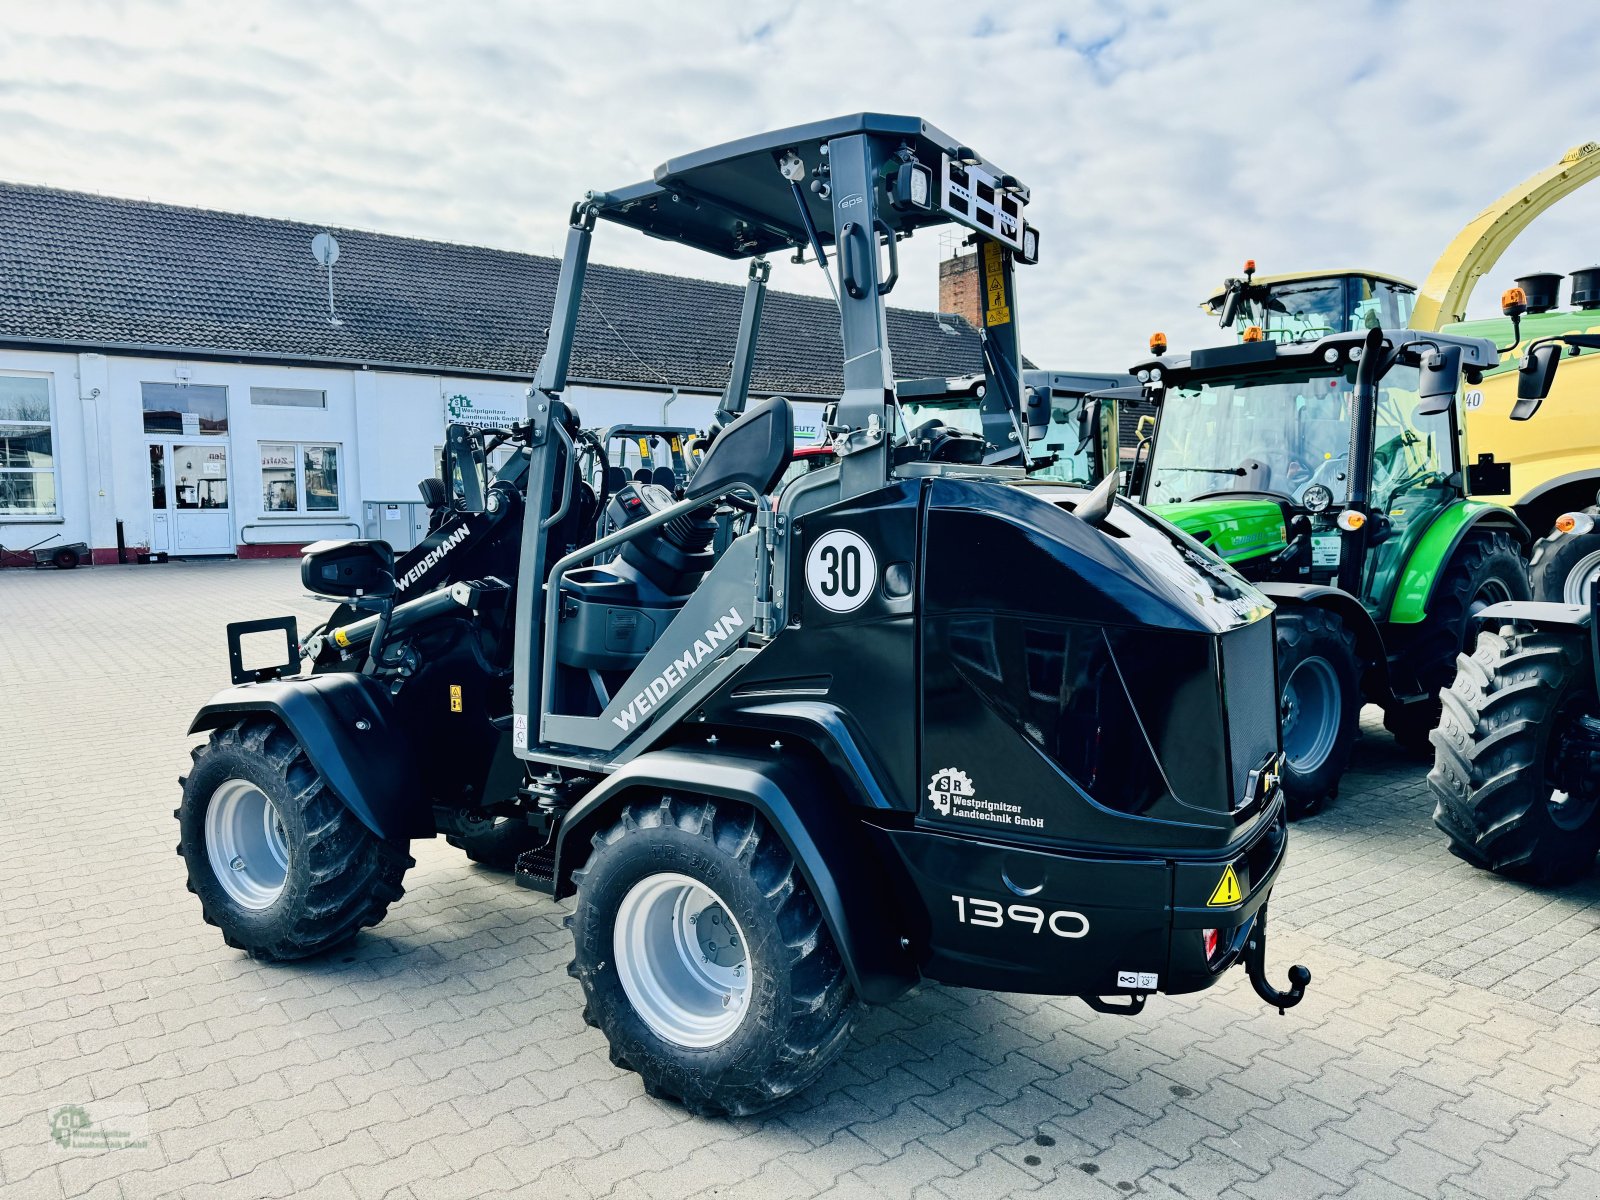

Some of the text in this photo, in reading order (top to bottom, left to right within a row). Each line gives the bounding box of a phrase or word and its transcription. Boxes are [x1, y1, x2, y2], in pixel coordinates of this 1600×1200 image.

[841, 196, 863, 208] eps
[1466, 392, 1481, 407] 40
[392, 522, 471, 592] WEIDEMANN
[820, 545, 861, 597] 30
[611, 606, 744, 731] WEIDEMANN
[940, 777, 962, 791] S R
[940, 793, 948, 805] B
[952, 795, 1022, 813] Westprignitzer
[952, 807, 1044, 828] Landtechnik GmbH
[951, 894, 1090, 939] 1390
